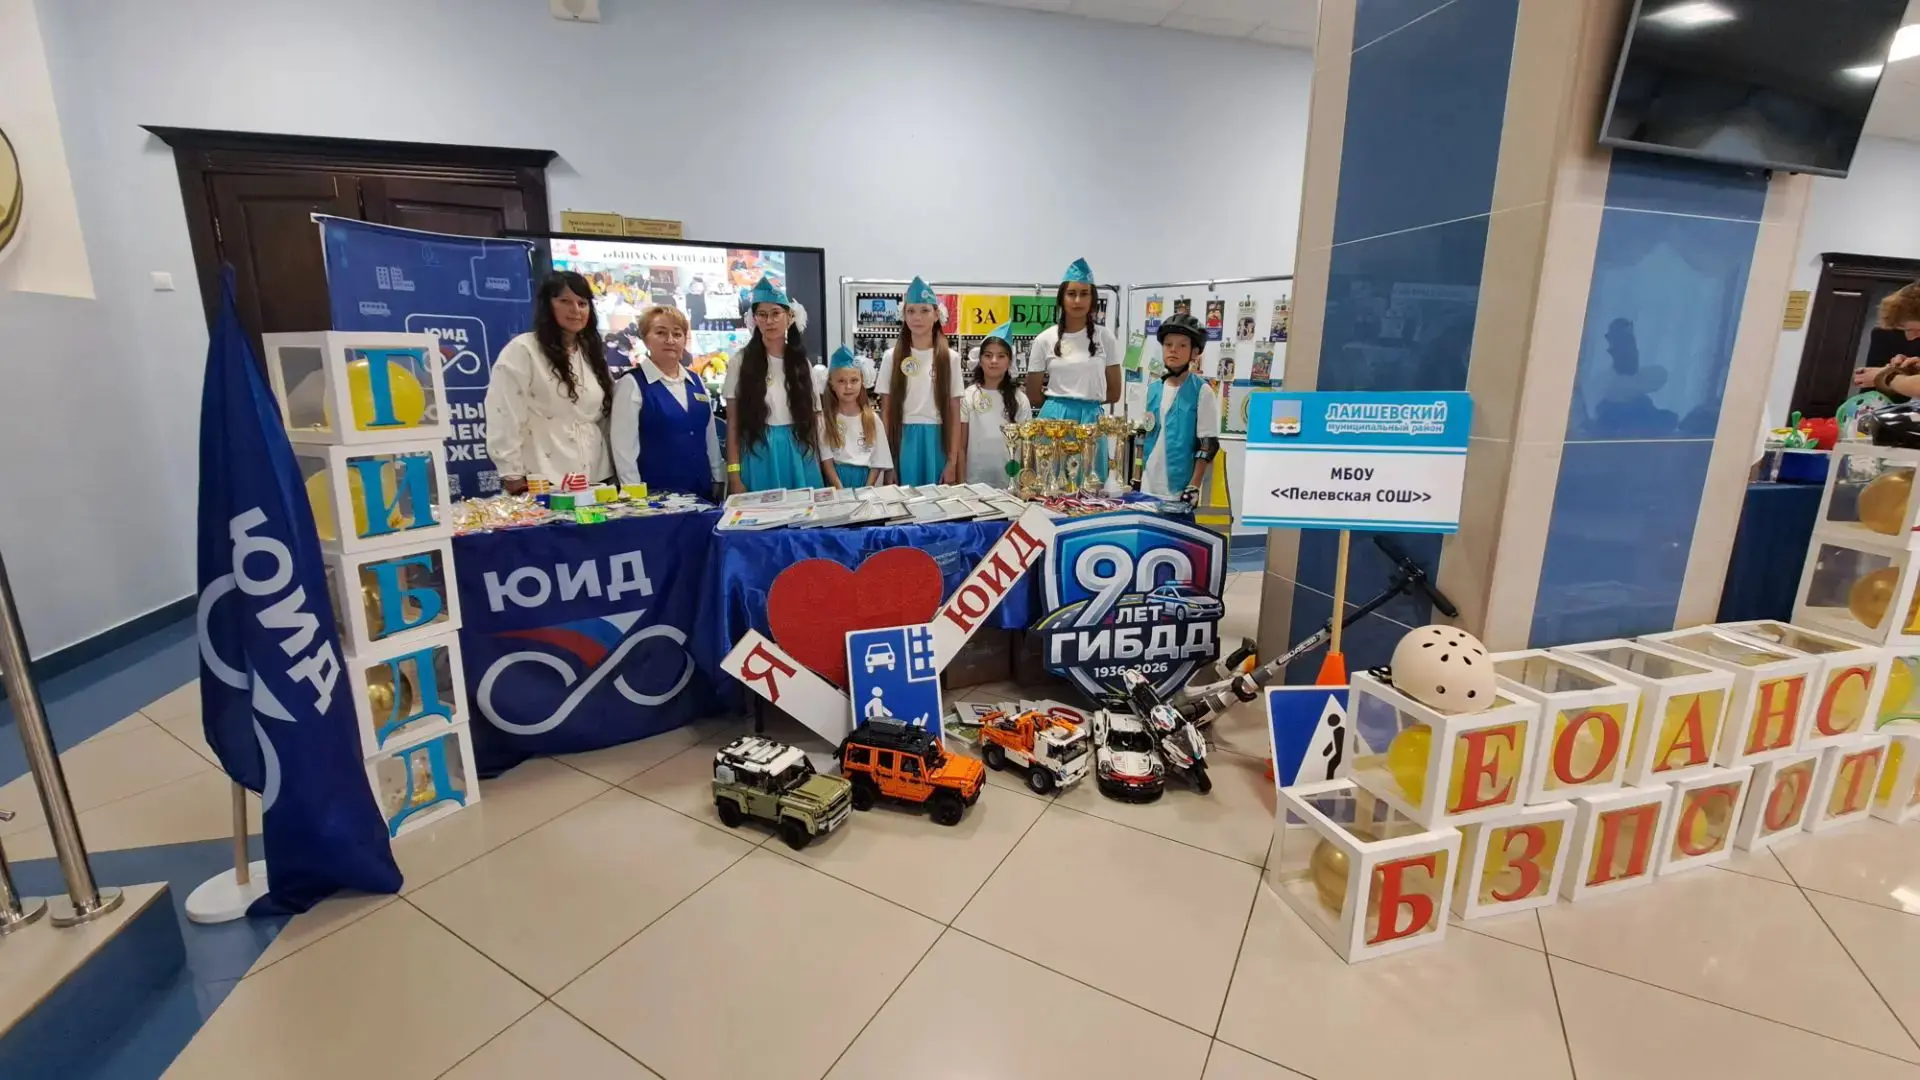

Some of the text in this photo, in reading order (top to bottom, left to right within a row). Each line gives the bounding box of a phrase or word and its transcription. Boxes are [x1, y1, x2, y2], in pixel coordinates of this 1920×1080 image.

[973, 307, 997, 324] ЗА
[1326, 401, 1447, 420] ЛАИШЕВСКИЙ
[1326, 421, 1443, 434] муниципальный район
[1330, 467, 1375, 481] МБОУ
[483, 550, 653, 612] ЮИД
[1073, 543, 1193, 627] 90
[229, 507, 342, 715] ЮИД
[740, 521, 1047, 704] Я ЮИД
[1115, 605, 1164, 624] ЛЕТ
[1050, 620, 1215, 664] ГИБДД
